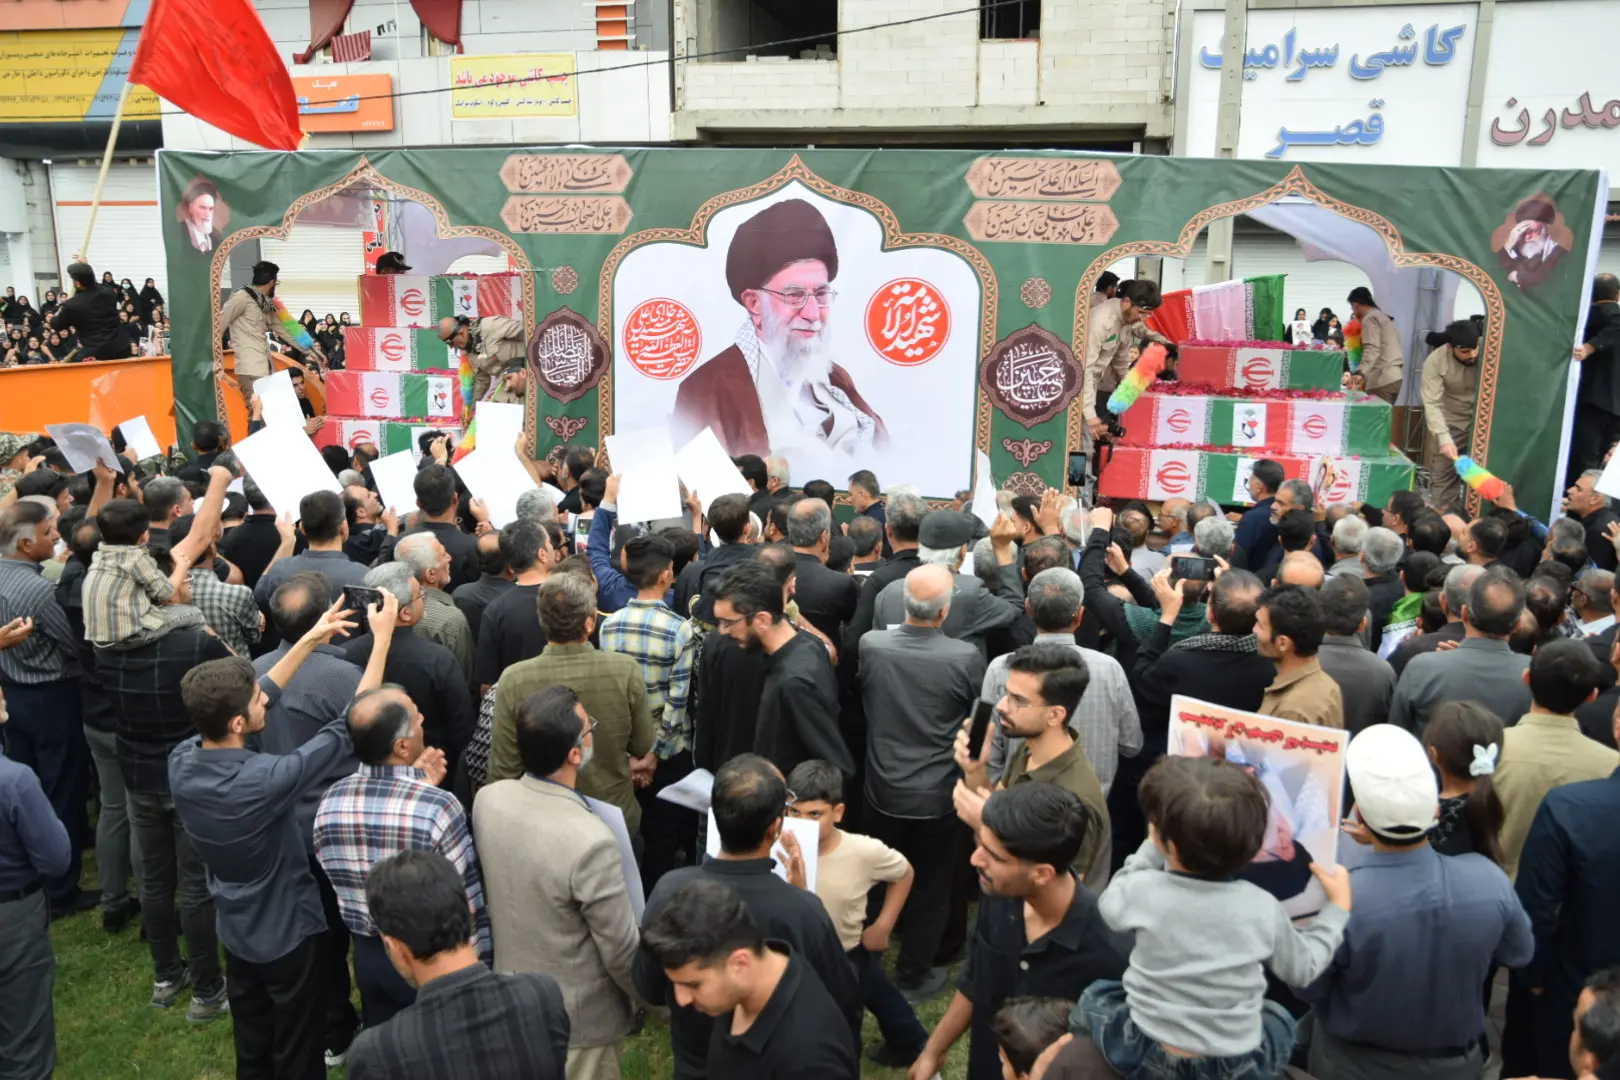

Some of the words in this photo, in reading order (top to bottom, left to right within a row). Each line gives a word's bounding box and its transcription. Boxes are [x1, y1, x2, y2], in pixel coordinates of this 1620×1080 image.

[1348, 23, 1467, 81] کاشی
[1265, 97, 1386, 160] قصر
[1490, 91, 1620, 146] مدرن
